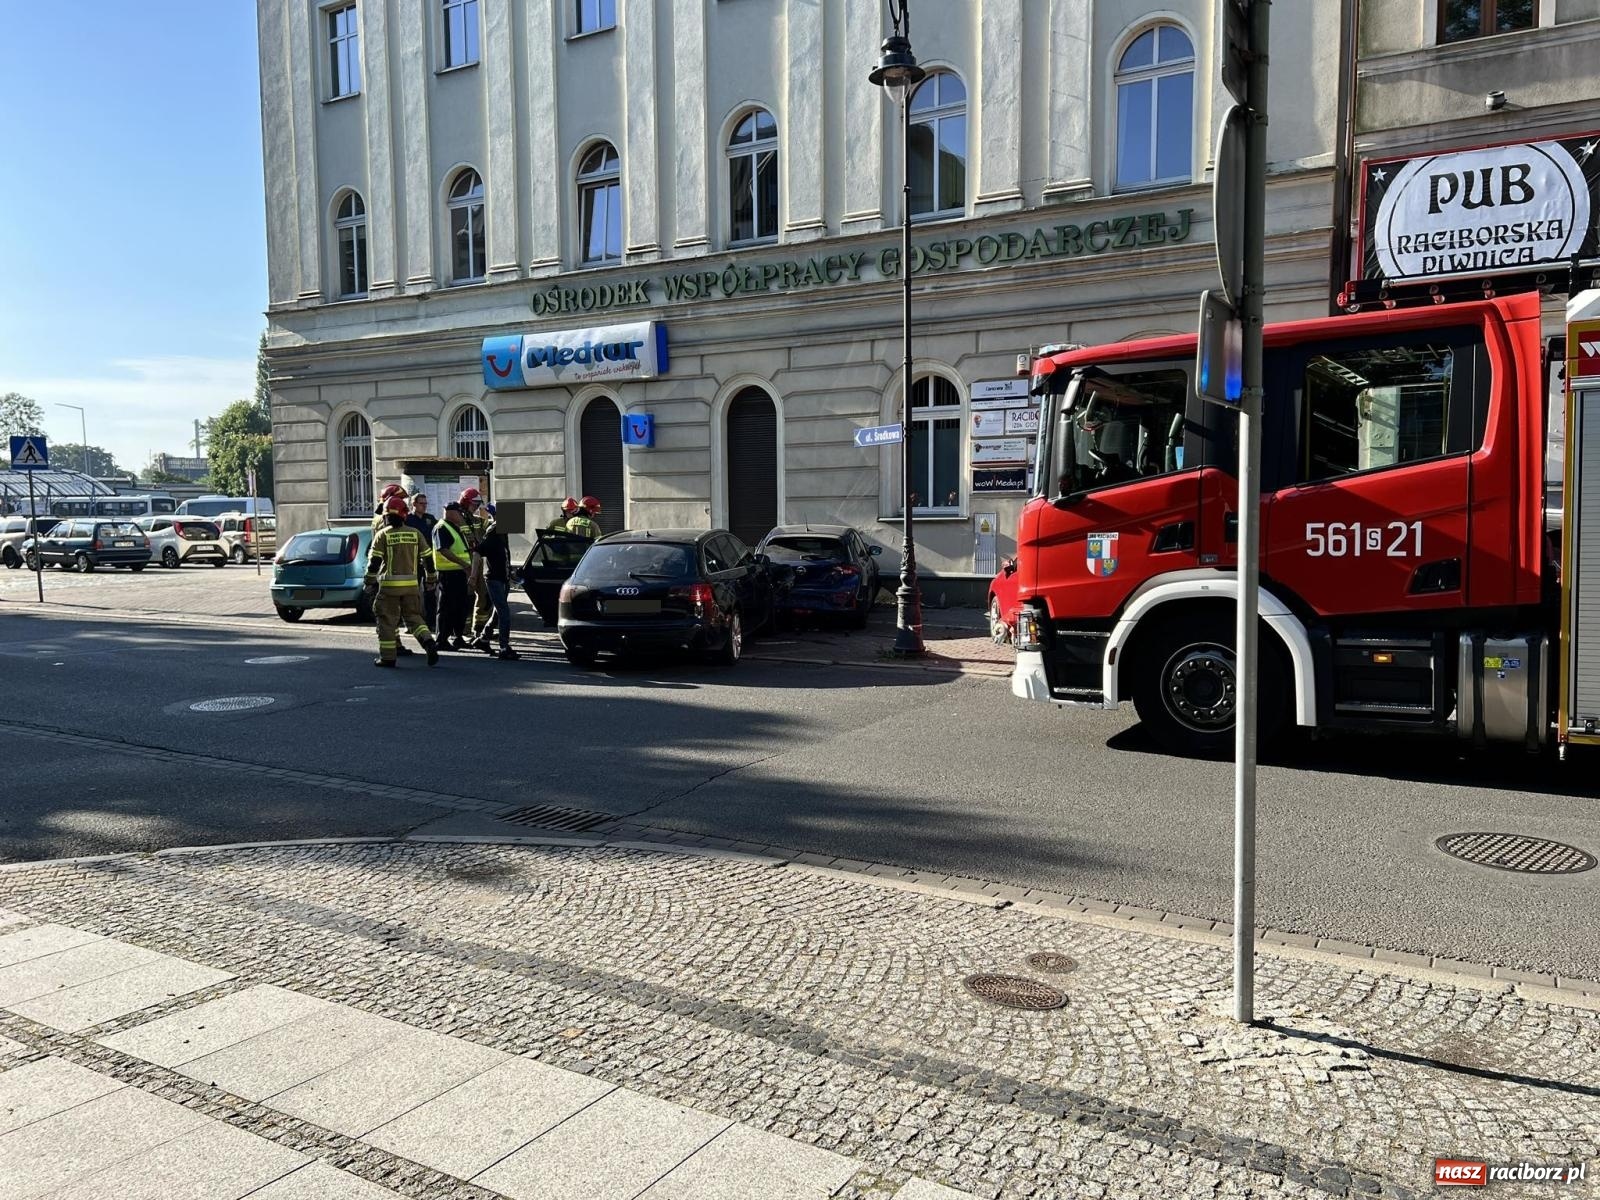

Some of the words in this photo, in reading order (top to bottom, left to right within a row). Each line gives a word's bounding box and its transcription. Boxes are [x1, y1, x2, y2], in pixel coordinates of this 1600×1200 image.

[1428, 163, 1535, 214] PUB
[1397, 219, 1564, 255] RACIBORSKA
[530, 278, 650, 315] OŚRODEK
[661, 251, 867, 301] WSPÓŁPRACY
[875, 208, 1194, 277] GOSPODARCZEJ
[1422, 246, 1534, 274] PIWNICA
[527, 341, 643, 368] Medtur
[1306, 522, 1360, 557] 561
[1387, 521, 1422, 557] 21
